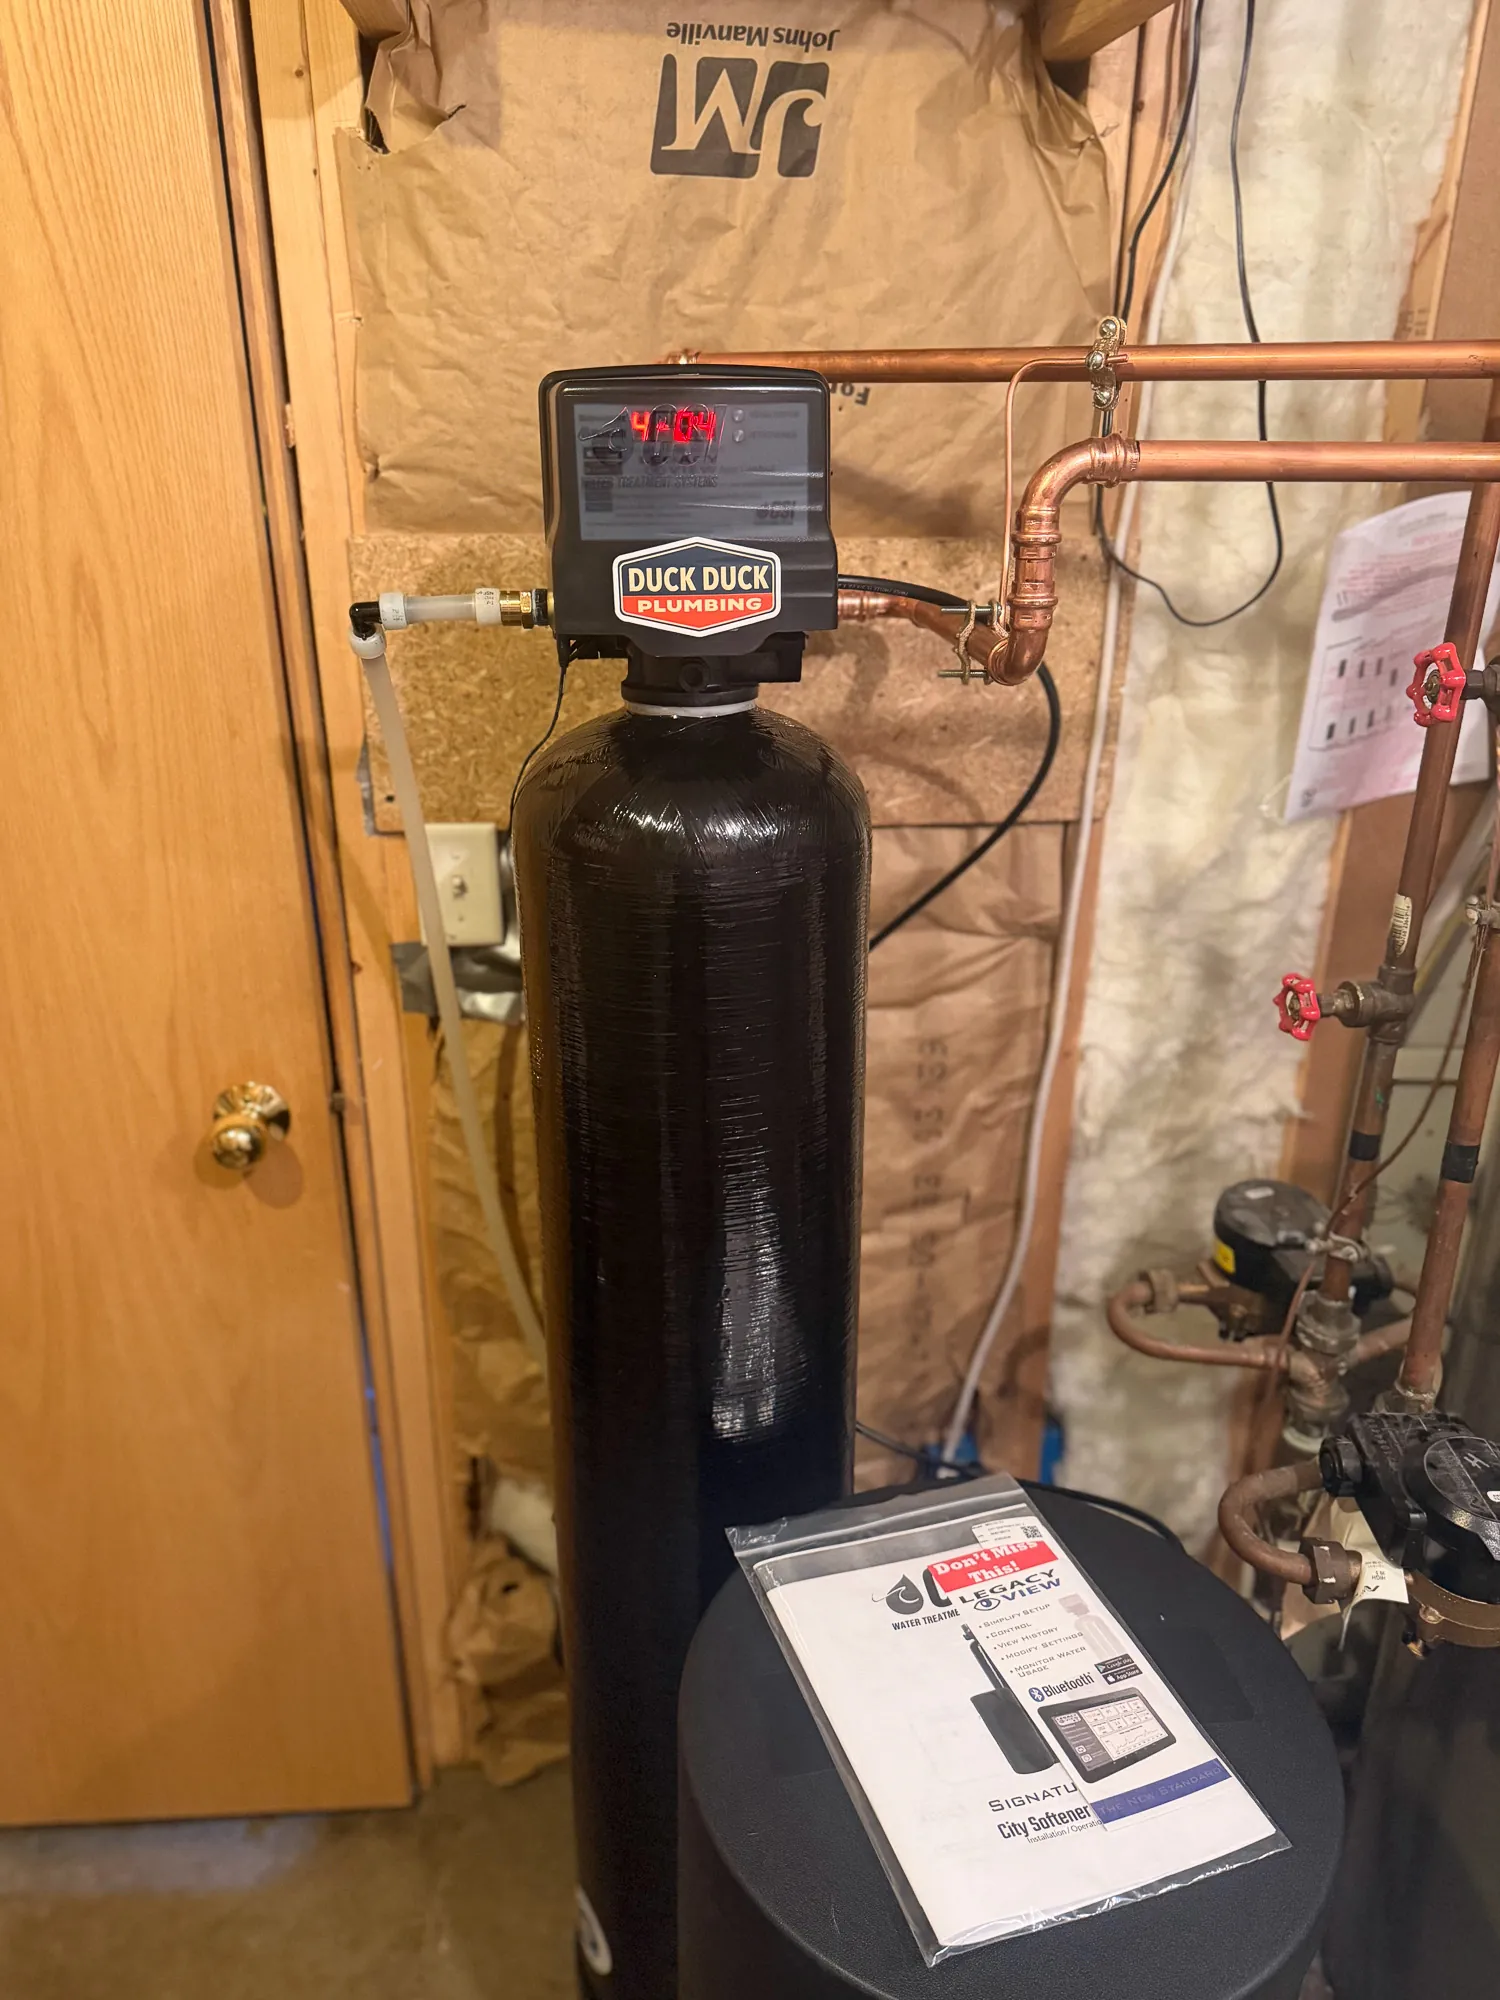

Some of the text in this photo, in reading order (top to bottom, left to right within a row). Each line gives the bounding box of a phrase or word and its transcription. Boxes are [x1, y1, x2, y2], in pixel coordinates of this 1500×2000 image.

[667, 22, 840, 52] Johns Manville
[651, 54, 829, 178] JM
[628, 565, 770, 592] DUCK DUCK
[637, 597, 762, 613] PLUMBING
[933, 1542, 1038, 1575] Don't Miss
[968, 1560, 1020, 1583] This!
[959, 1569, 1054, 1603] LEGACY
[1001, 1578, 1060, 1600] VIEW
[892, 1617, 921, 1630] WATER
[1042, 1673, 1094, 1697] Bluetooth
[1099, 1767, 1221, 1815] THE NEW STANDARD
[997, 1805, 1091, 1839] City Softener
[1027, 1829, 1067, 1843] Installation
